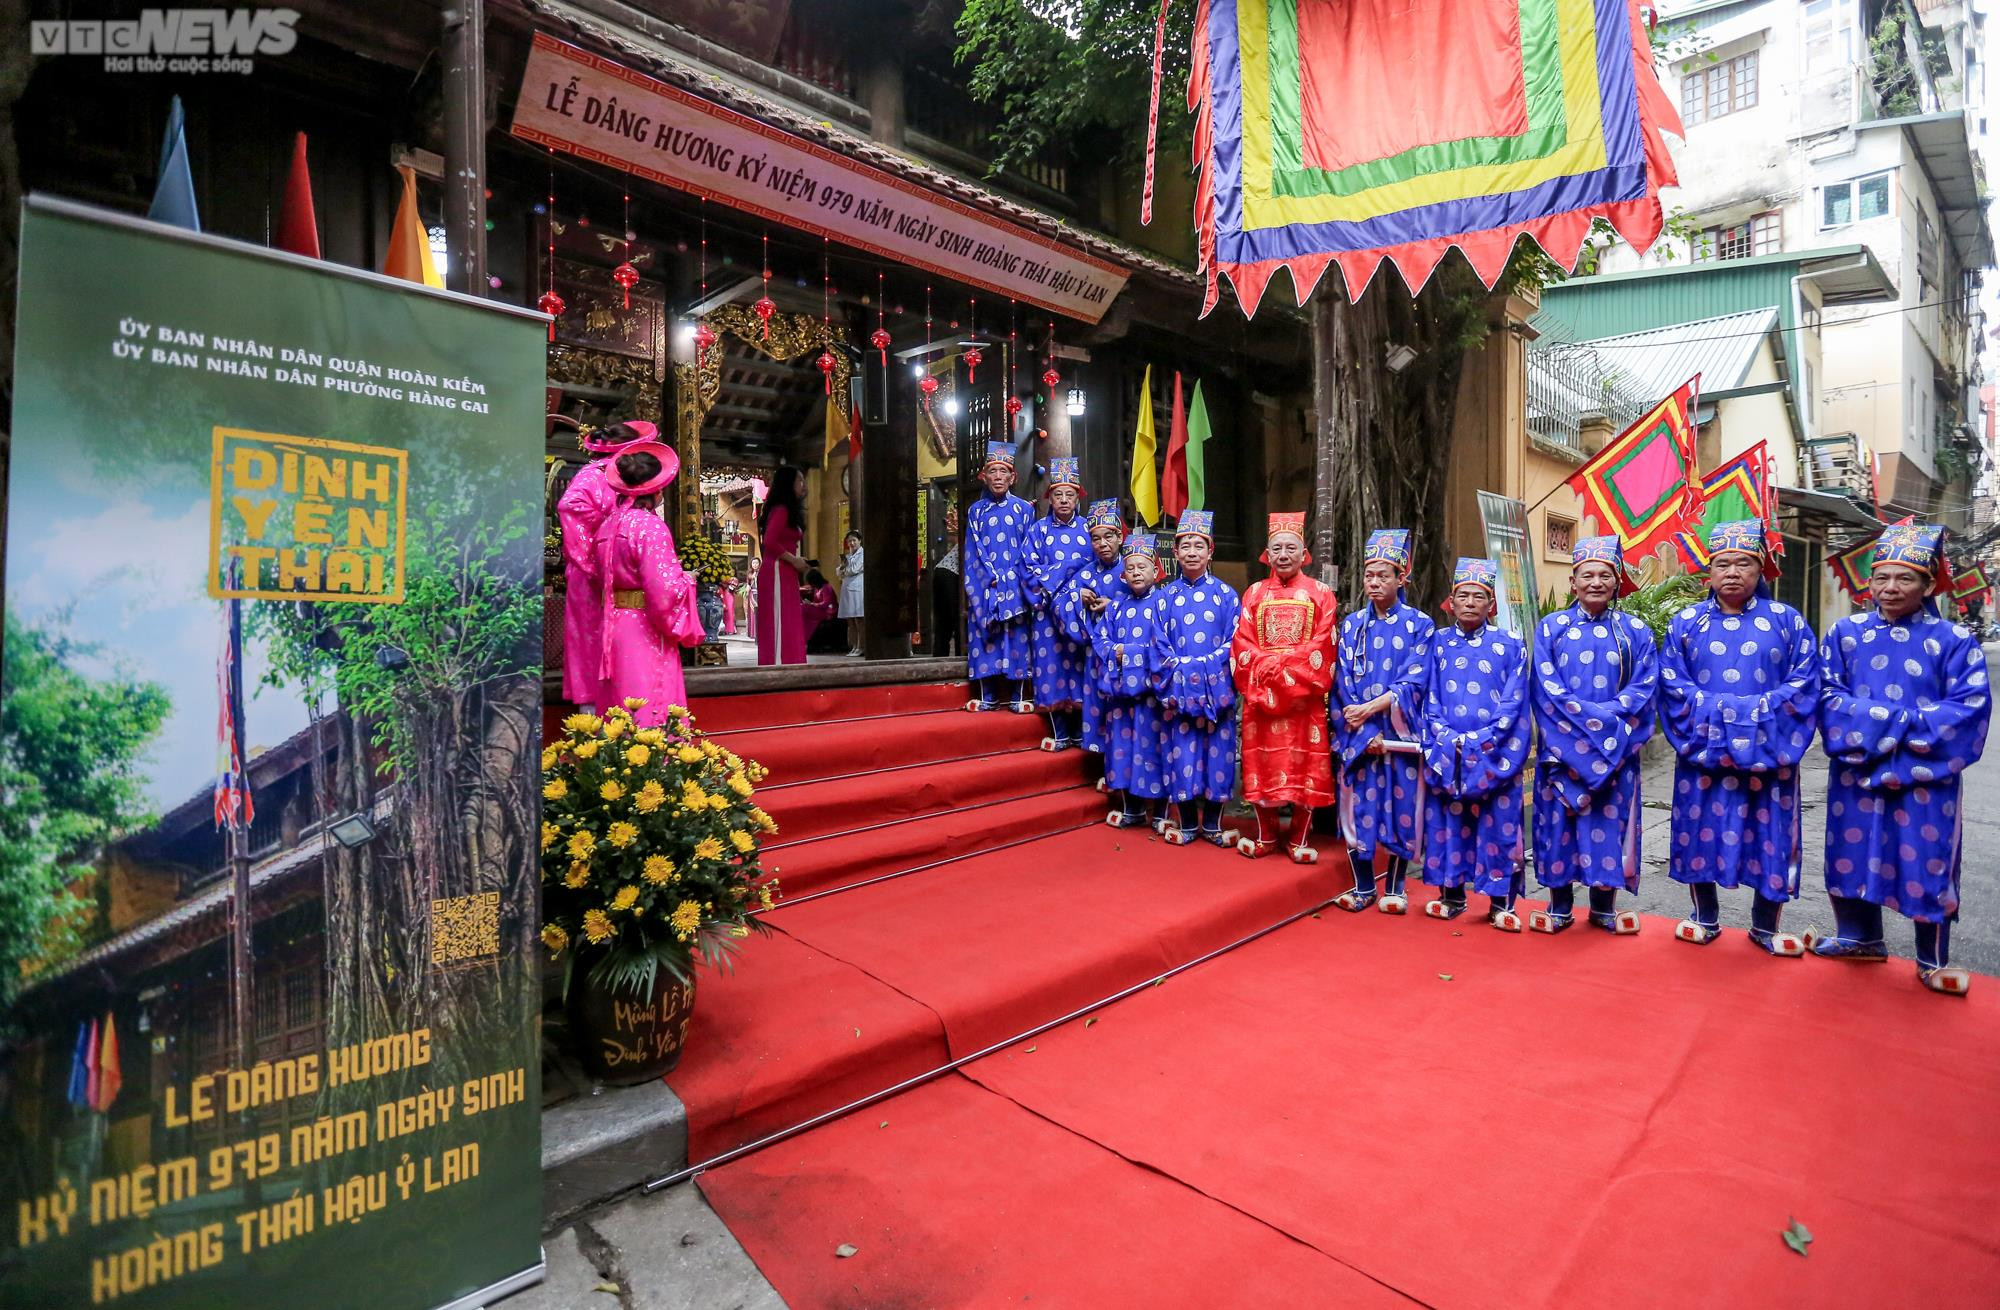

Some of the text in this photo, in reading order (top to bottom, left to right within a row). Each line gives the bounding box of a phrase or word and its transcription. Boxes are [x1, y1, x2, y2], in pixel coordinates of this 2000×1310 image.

[546, 76, 1108, 304] LỄ DÂNG HƯƠNG KỶ NIỆM 979 NĂM NGÀY SINH HOÀNG THÁI HẬU Ỷ LAN
[112, 339, 490, 415] ỦY BAN NHÂN DÂN PHƯỜNG HÀNG GAI
[119, 317, 487, 396] ỦY BAN NHÂN DÂN QUẬN HOÀN KIẾM
[226, 444, 390, 502] ĐÌNH
[232, 494, 389, 549] YÊN
[226, 546, 385, 593] THÁI
[165, 1028, 431, 1128] LỄ DÂNG HƯƠNG
[18, 1068, 525, 1247] KỶ NIỆM 979 NĂM NGÀY SINH
[92, 1142, 480, 1303] HOÀNG THÁI HẬU Ỷ LAN
